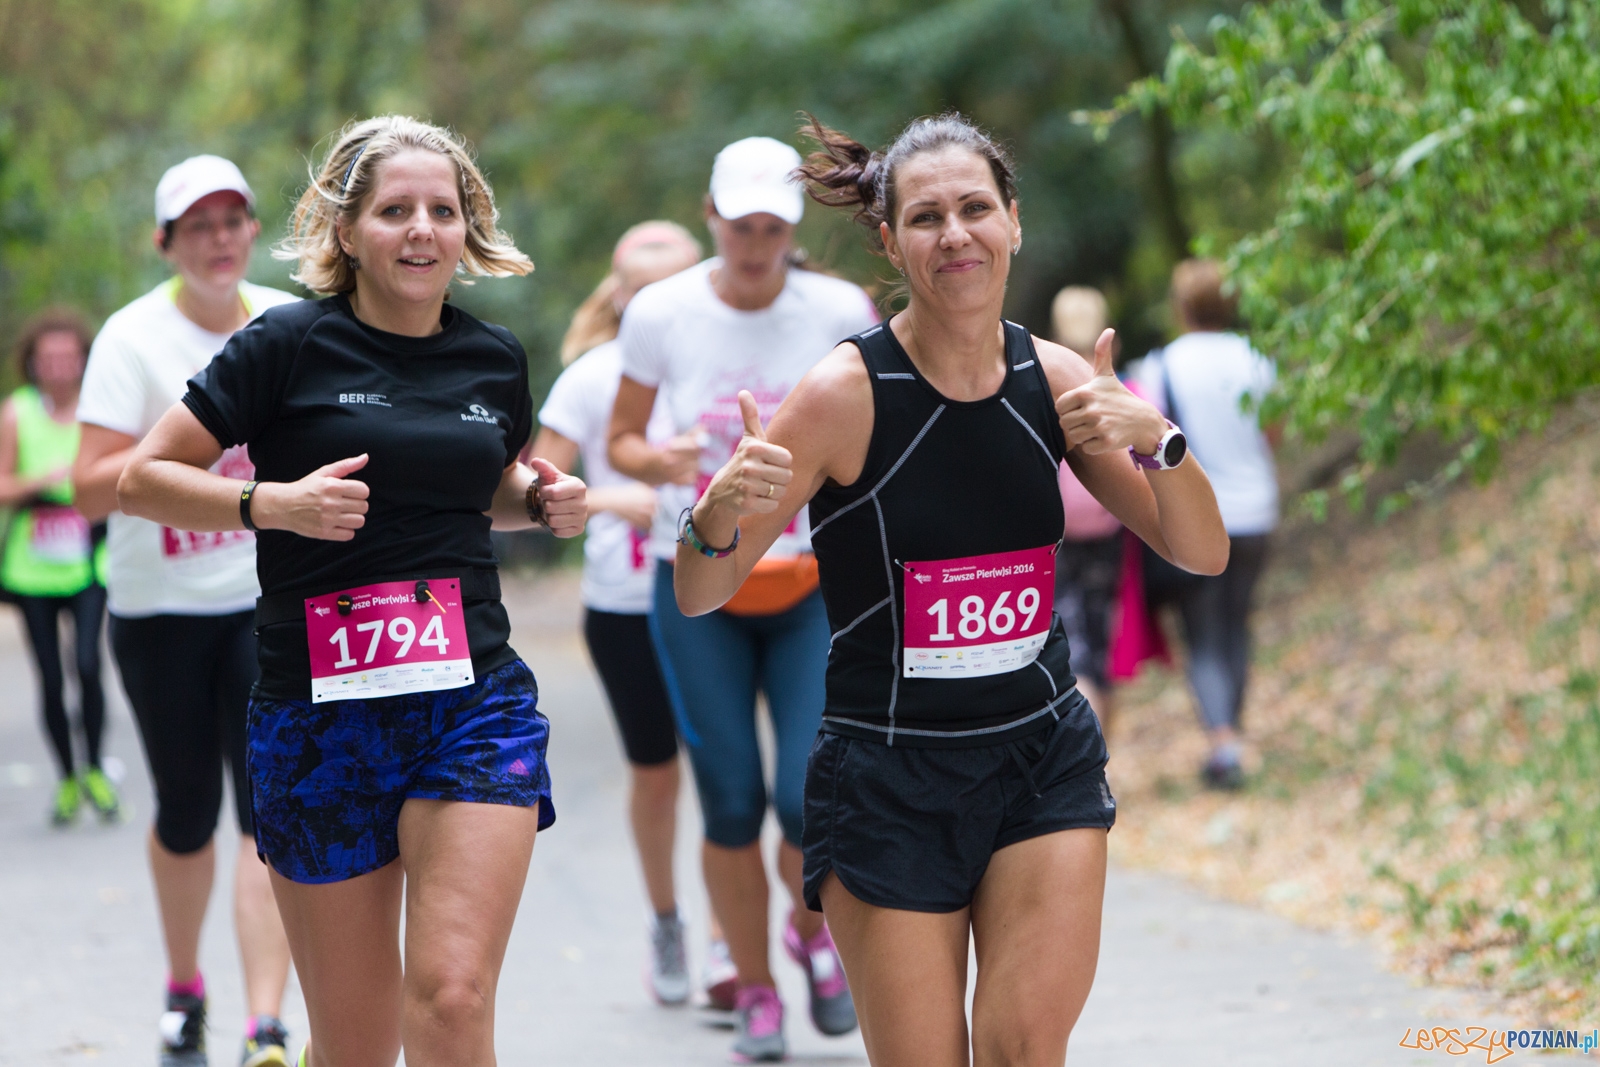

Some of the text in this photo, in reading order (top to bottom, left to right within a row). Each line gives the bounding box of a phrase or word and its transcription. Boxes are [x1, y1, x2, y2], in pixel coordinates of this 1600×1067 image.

[339, 393, 365, 404] BER
[460, 413, 484, 423] Berlin
[942, 570, 975, 583] Zawsze
[976, 566, 1012, 580] Pier(w)si
[1013, 563, 1035, 575] 2016
[351, 601, 371, 611] wsze
[372, 594, 409, 607] Pier(w)si
[926, 587, 1041, 642] 1869
[329, 615, 450, 669] 1794
